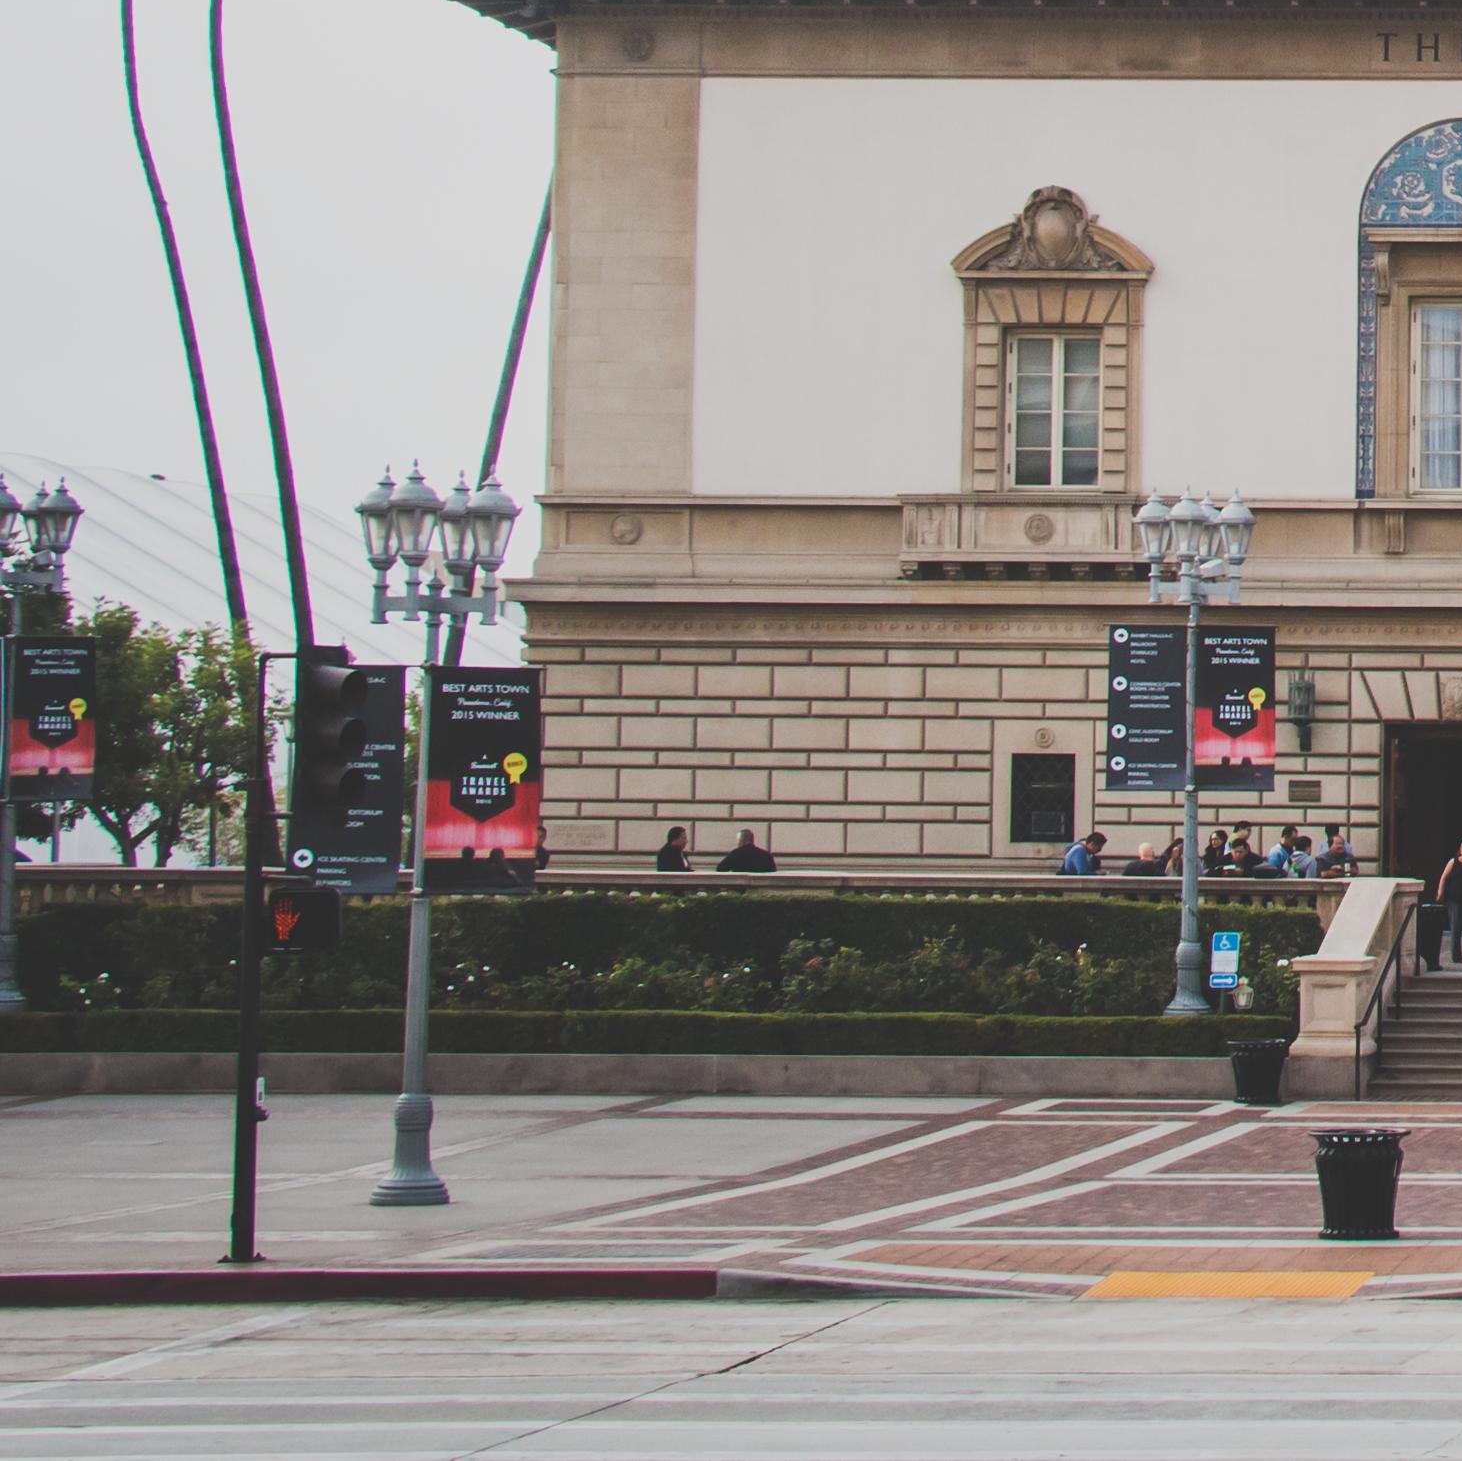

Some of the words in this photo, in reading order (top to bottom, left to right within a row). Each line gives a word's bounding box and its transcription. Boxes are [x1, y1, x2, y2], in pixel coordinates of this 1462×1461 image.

[442, 684, 465, 692] BEST
[468, 684, 492, 694] ARTS
[495, 684, 530, 694] TOWN
[451, 710, 474, 720] 2015
[476, 711, 520, 720] WINNER
[462, 777, 506, 786] TRAVEL
[462, 787, 506, 796] AWARDS
